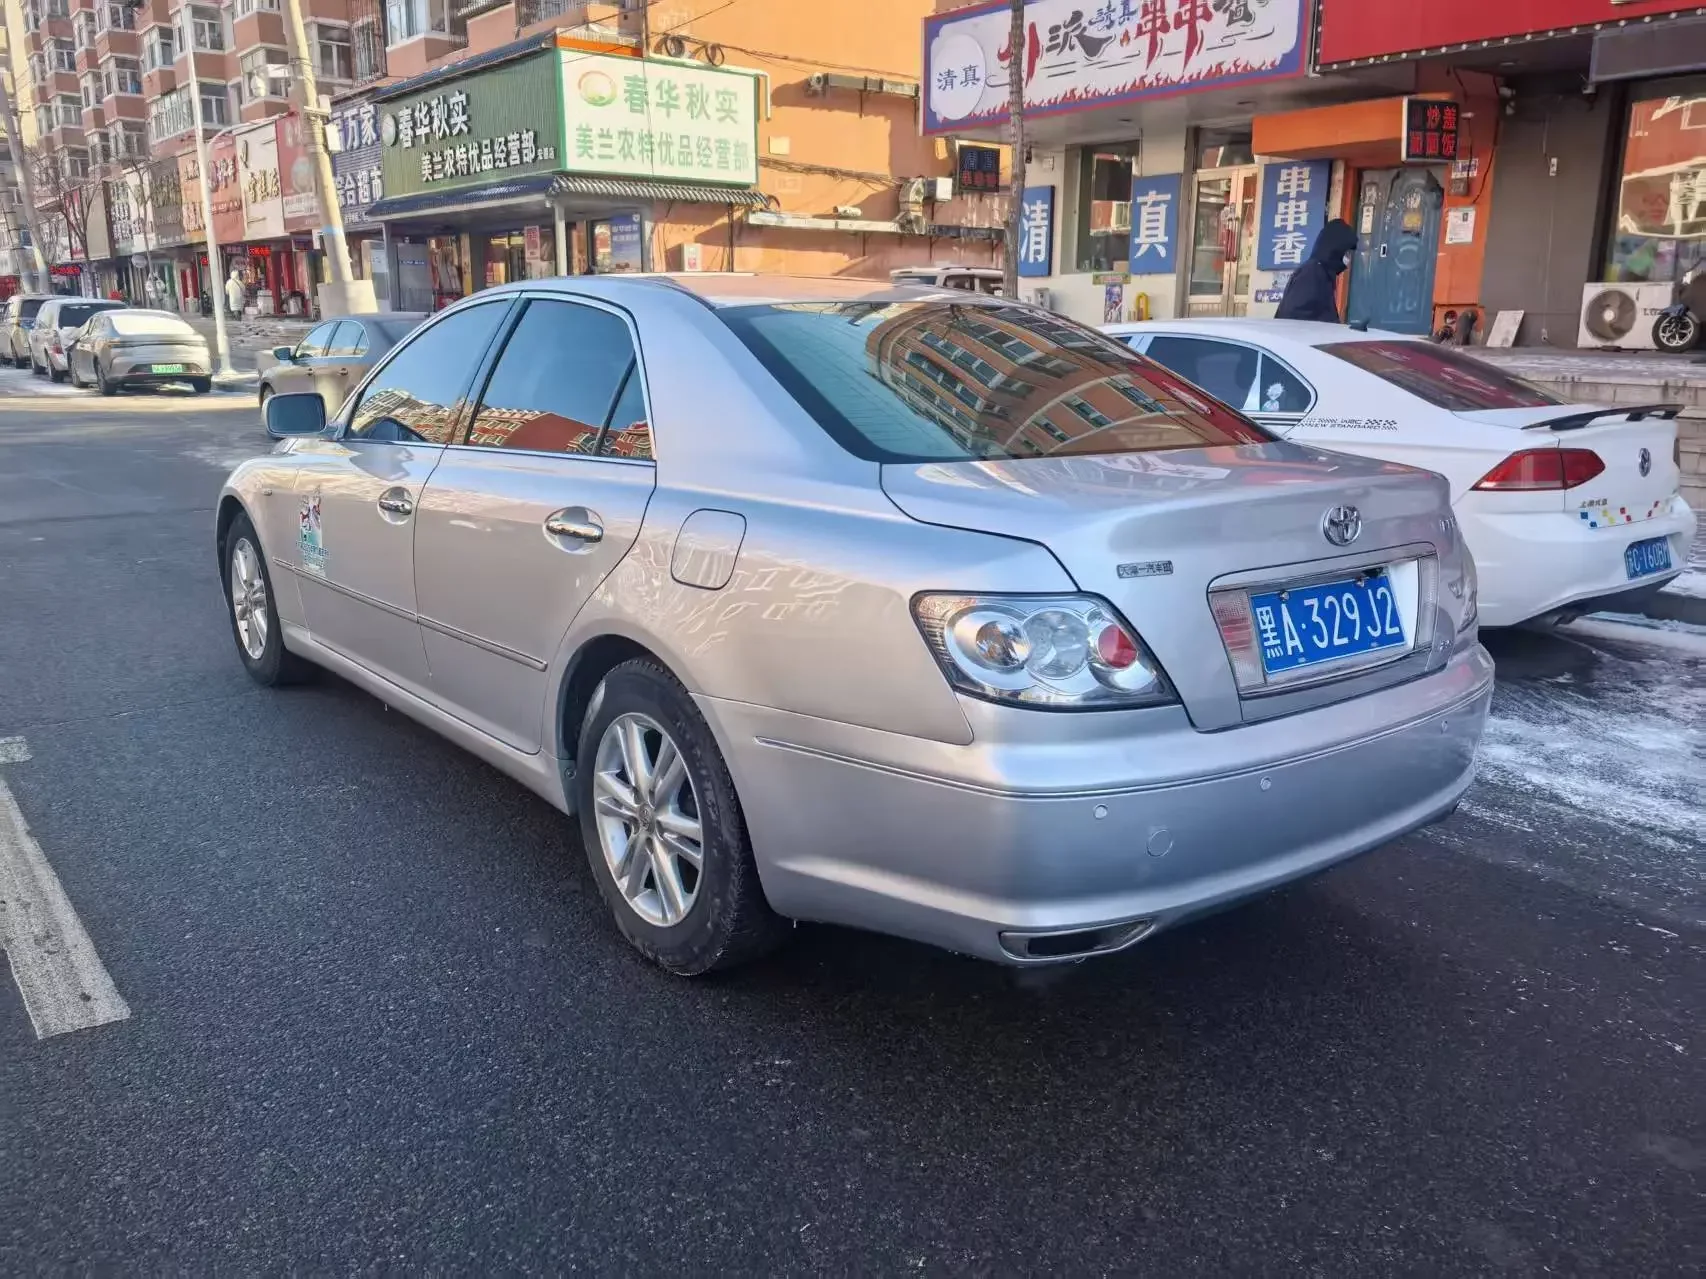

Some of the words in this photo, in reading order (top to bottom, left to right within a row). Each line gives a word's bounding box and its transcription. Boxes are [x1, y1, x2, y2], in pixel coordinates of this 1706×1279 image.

[624, 75, 739, 125] 春华秋实
[937, 65, 980, 91] 清真
[399, 90, 470, 149] 春华秋实
[421, 129, 536, 182] 美兰农特优品经营部
[576, 122, 750, 172] 美兰农特优品经营部
[336, 166, 383, 208] 综合超市
[1020, 200, 1049, 264] 清
[1135, 190, 1172, 259] 真
[1272, 167, 1311, 265] 串串香
[1256, 587, 1401, 659] 黑A·329J2
